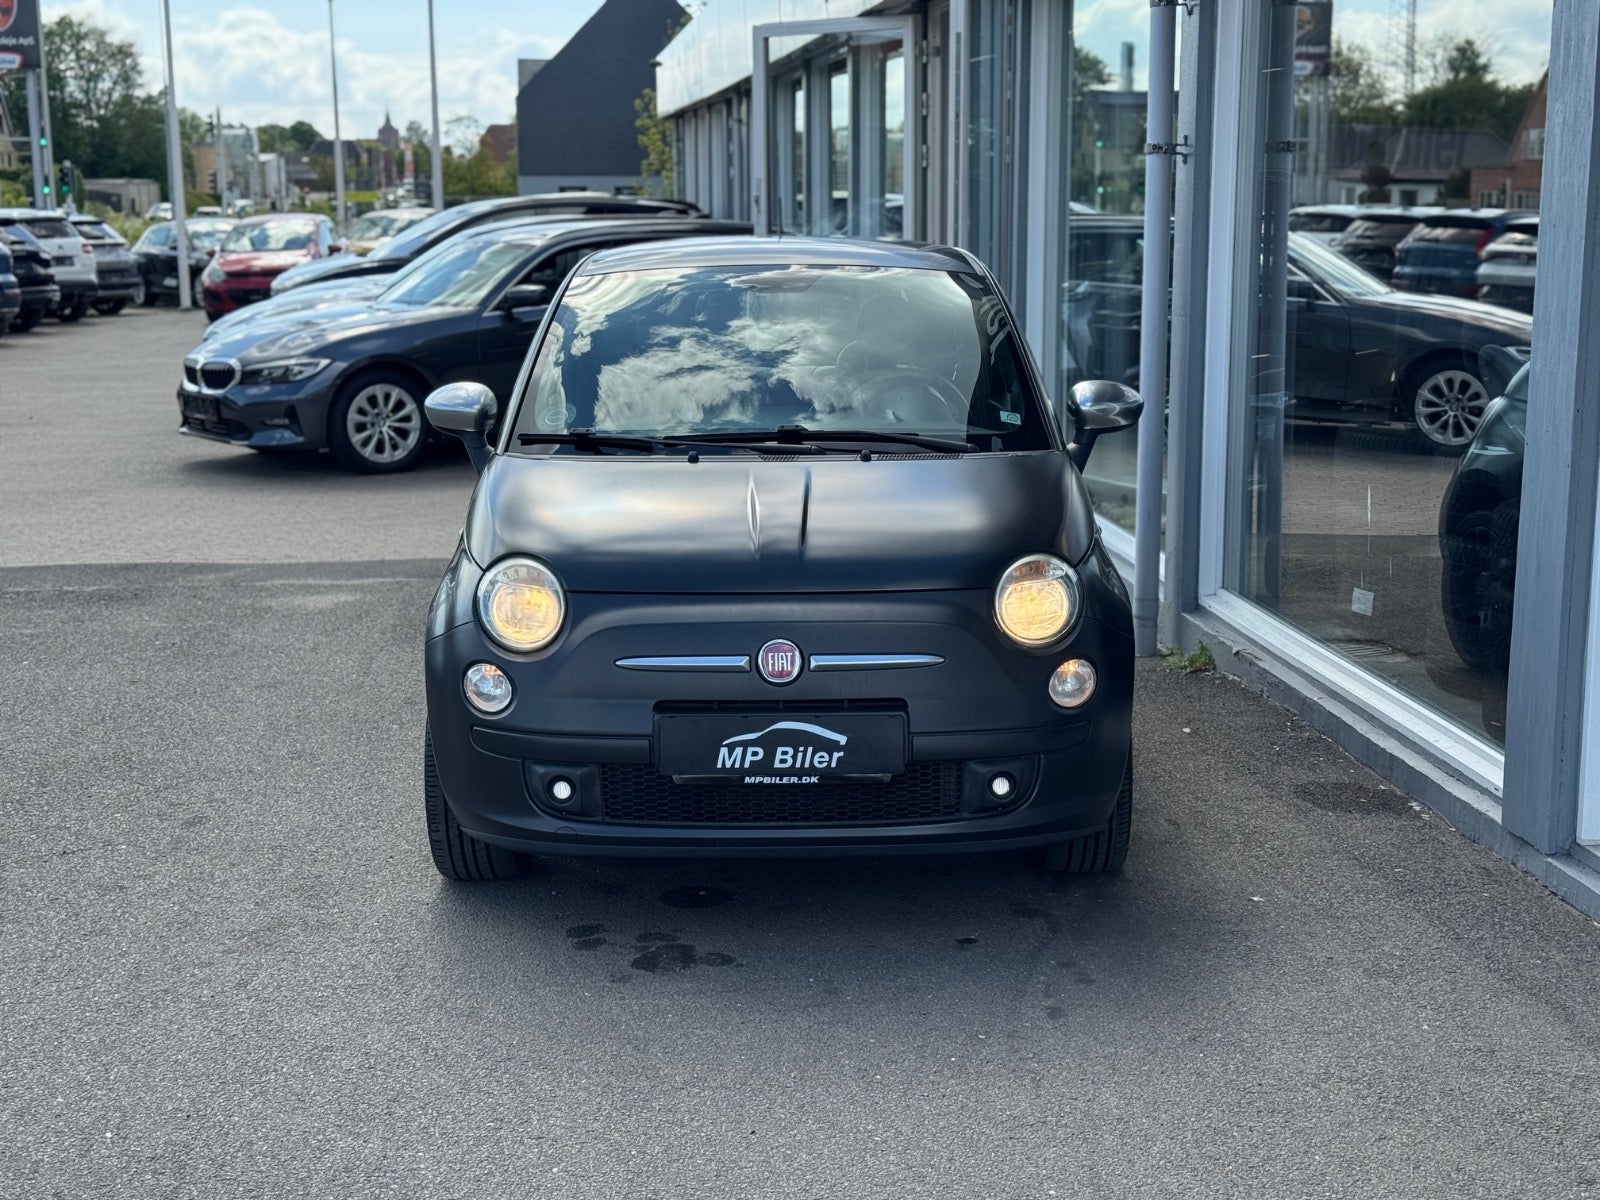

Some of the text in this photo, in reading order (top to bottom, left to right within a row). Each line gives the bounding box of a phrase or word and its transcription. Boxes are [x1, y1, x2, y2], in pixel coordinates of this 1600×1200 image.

[768, 652, 793, 672] FIAT
[717, 746, 844, 768] MP Biler
[744, 775, 820, 784] MPBILER.DK
